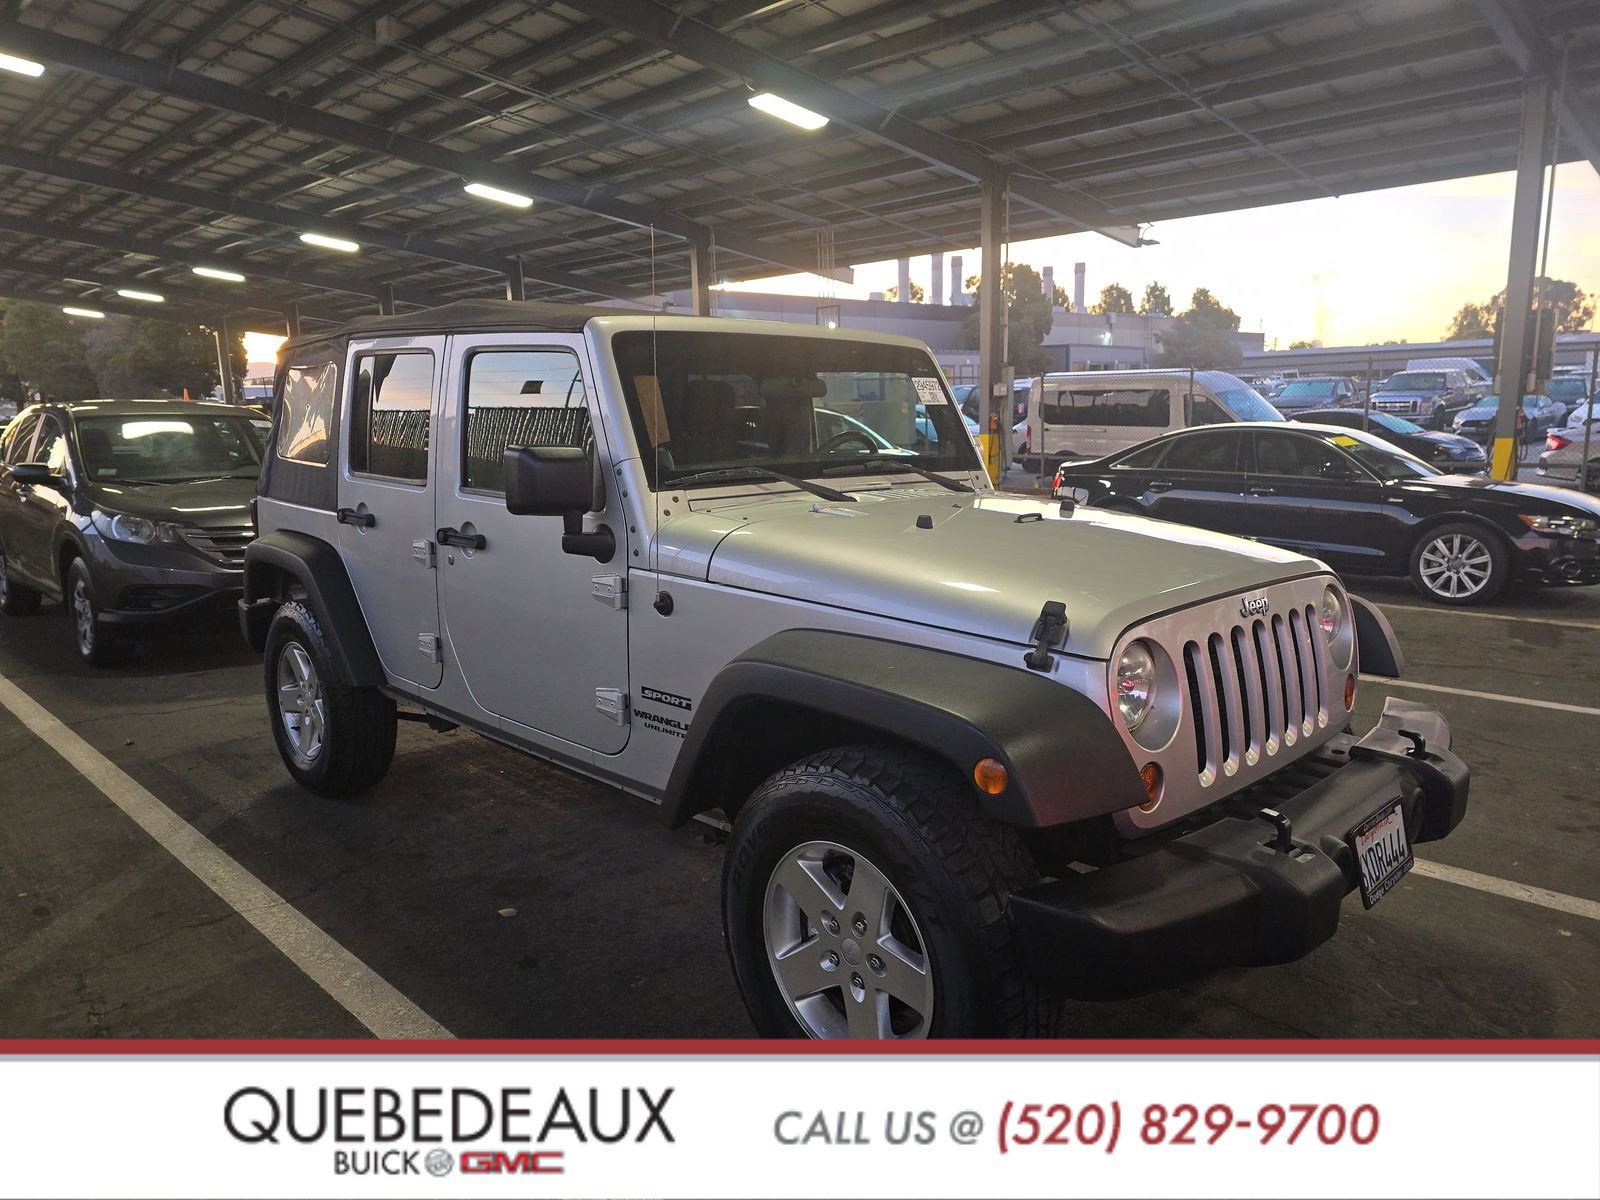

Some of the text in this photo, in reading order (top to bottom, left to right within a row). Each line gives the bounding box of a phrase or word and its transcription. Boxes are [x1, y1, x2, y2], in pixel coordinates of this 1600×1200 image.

[1240, 596, 1269, 618] Jeep
[643, 689, 690, 707] SPORT
[634, 708, 690, 731] WRANGLE
[644, 722, 687, 739] UNLIMITE
